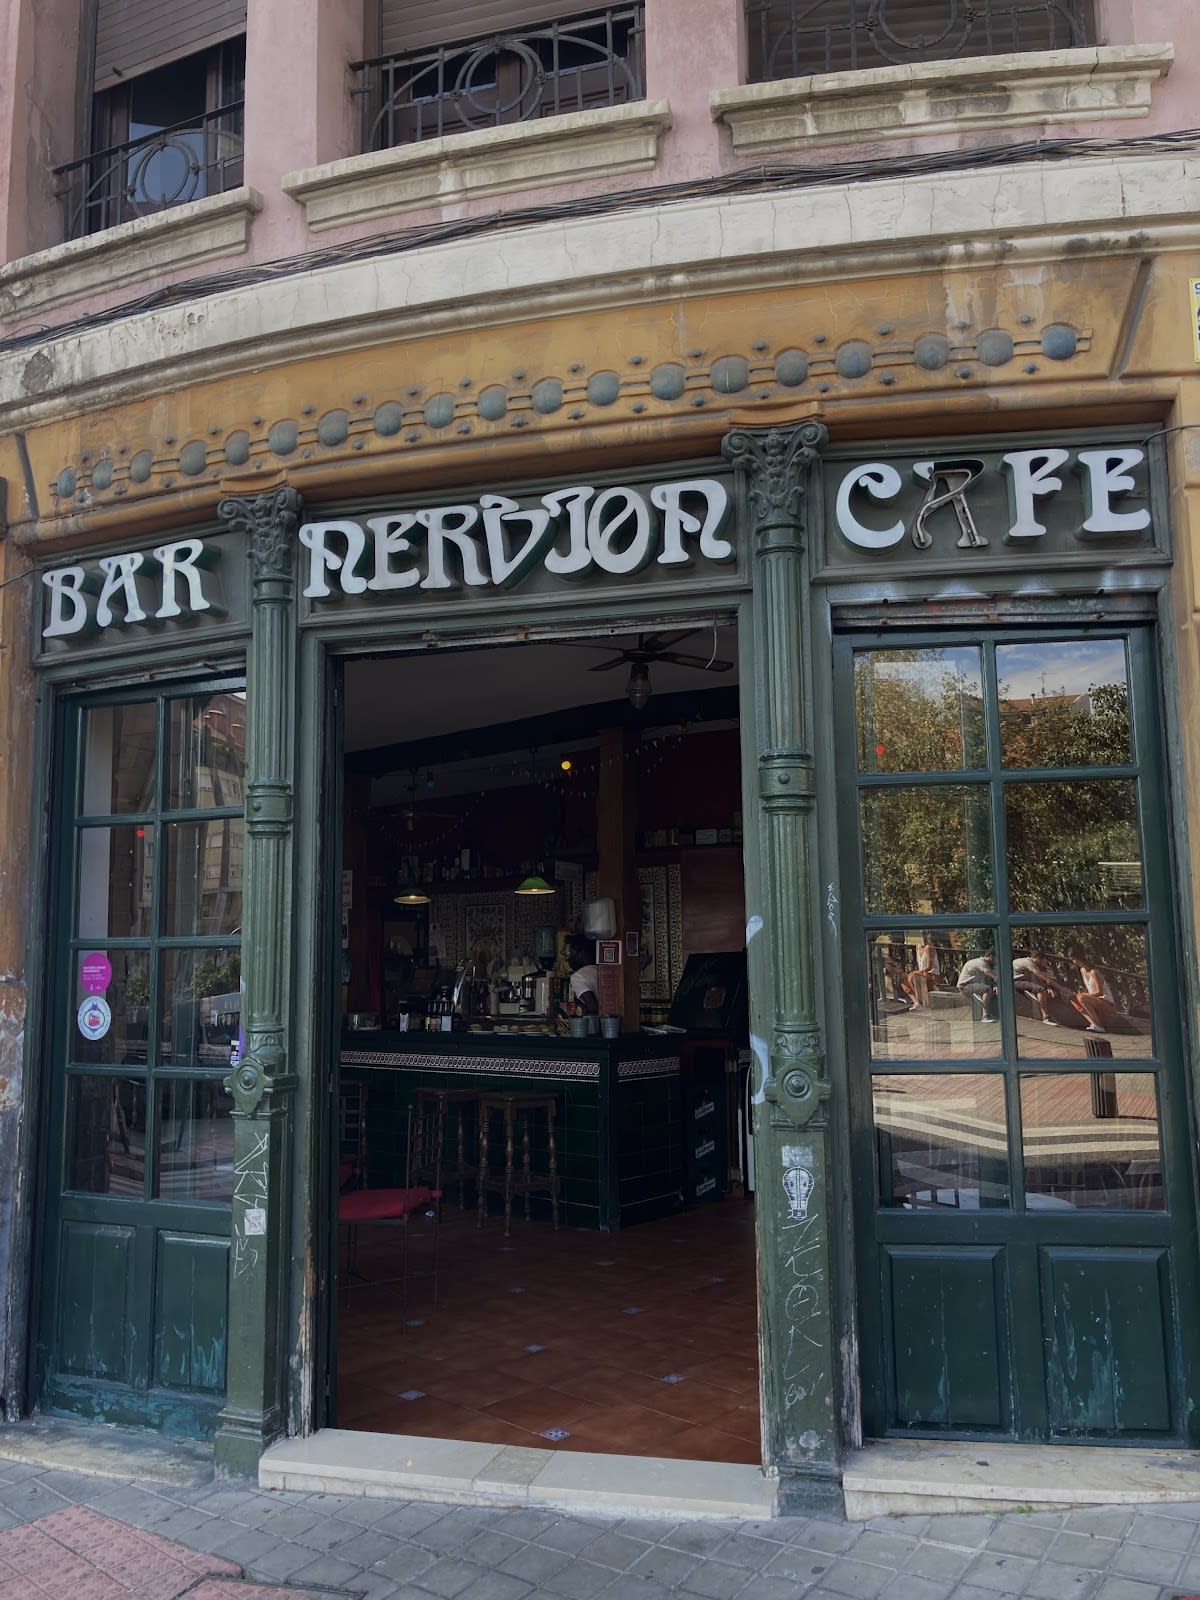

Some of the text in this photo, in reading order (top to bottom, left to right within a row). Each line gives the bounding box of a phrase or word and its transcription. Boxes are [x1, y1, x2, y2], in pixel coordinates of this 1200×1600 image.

[298, 479, 732, 598] NERVION
[836, 448, 1151, 549] CAFE
[42, 539, 211, 638] BAR
